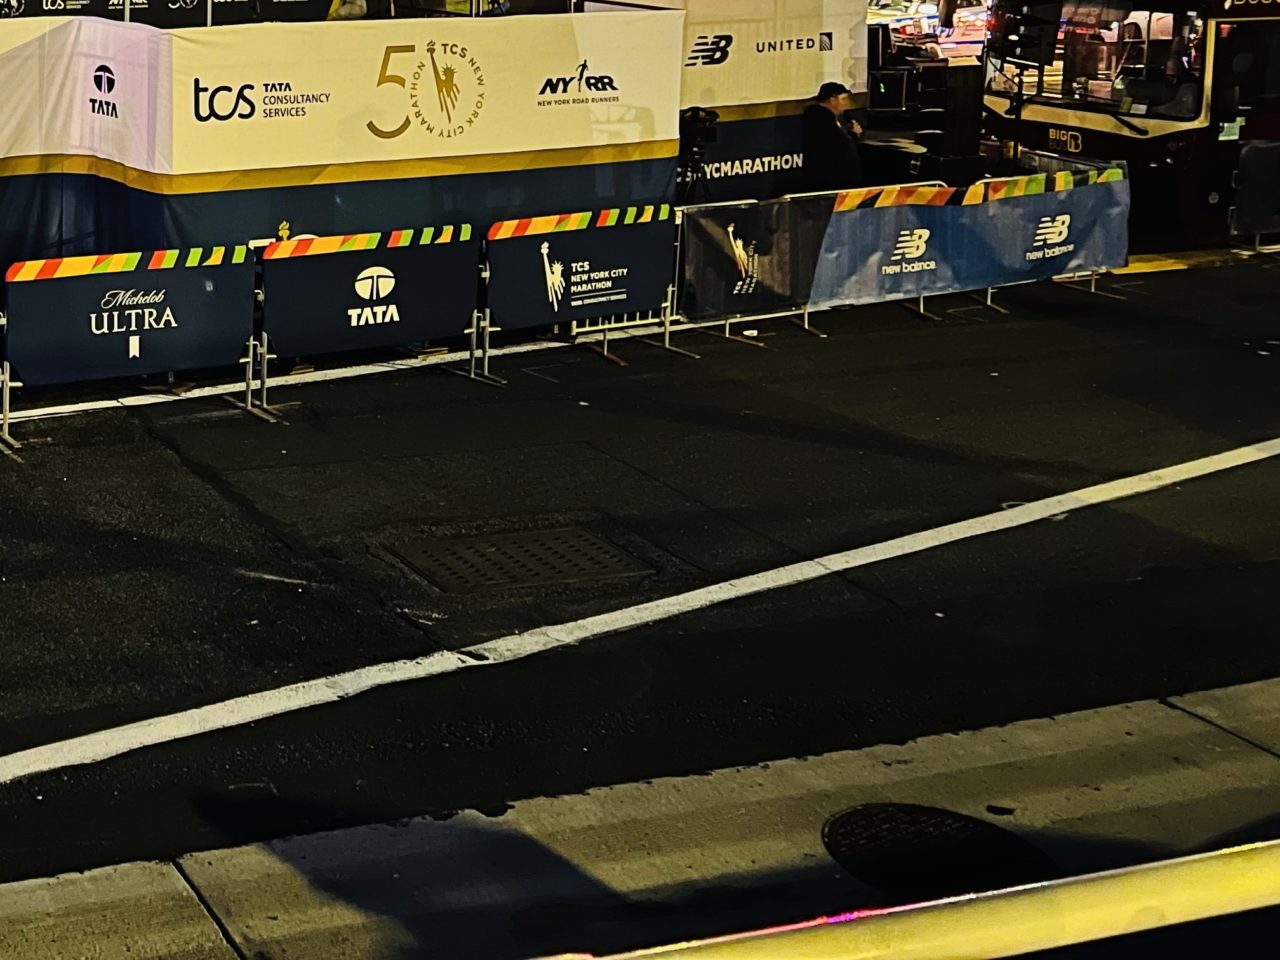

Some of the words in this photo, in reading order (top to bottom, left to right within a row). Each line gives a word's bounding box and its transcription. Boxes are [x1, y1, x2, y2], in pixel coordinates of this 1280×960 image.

[441, 43, 468, 60] TCS
[755, 37, 816, 54] UNITED
[467, 56, 486, 87] NEW
[263, 82, 292, 93] TATA
[193, 77, 257, 123] tcs
[262, 92, 331, 107] CONSULTANCY
[410, 60, 435, 135] MARATHON
[537, 100, 553, 108] NEW
[553, 99, 571, 107] YORK
[571, 97, 590, 105] ROAD
[590, 95, 620, 104] RUNNERS
[89, 98, 119, 119] TATA
[262, 106, 307, 119] SERVICES
[465, 91, 486, 128] YORK
[437, 124, 465, 139] CITY
[1048, 128, 1068, 141] BIG
[1025, 250, 1044, 261] new
[570, 261, 590, 273] TCS
[881, 263, 901, 275] new
[570, 273, 589, 283] NEW
[590, 271, 610, 281] YORK
[610, 268, 628, 278] CITY
[570, 280, 612, 294] MARATHON
[100, 288, 166, 310] Michelob
[89, 306, 178, 335] ULTRA
[348, 303, 400, 327] TATA
